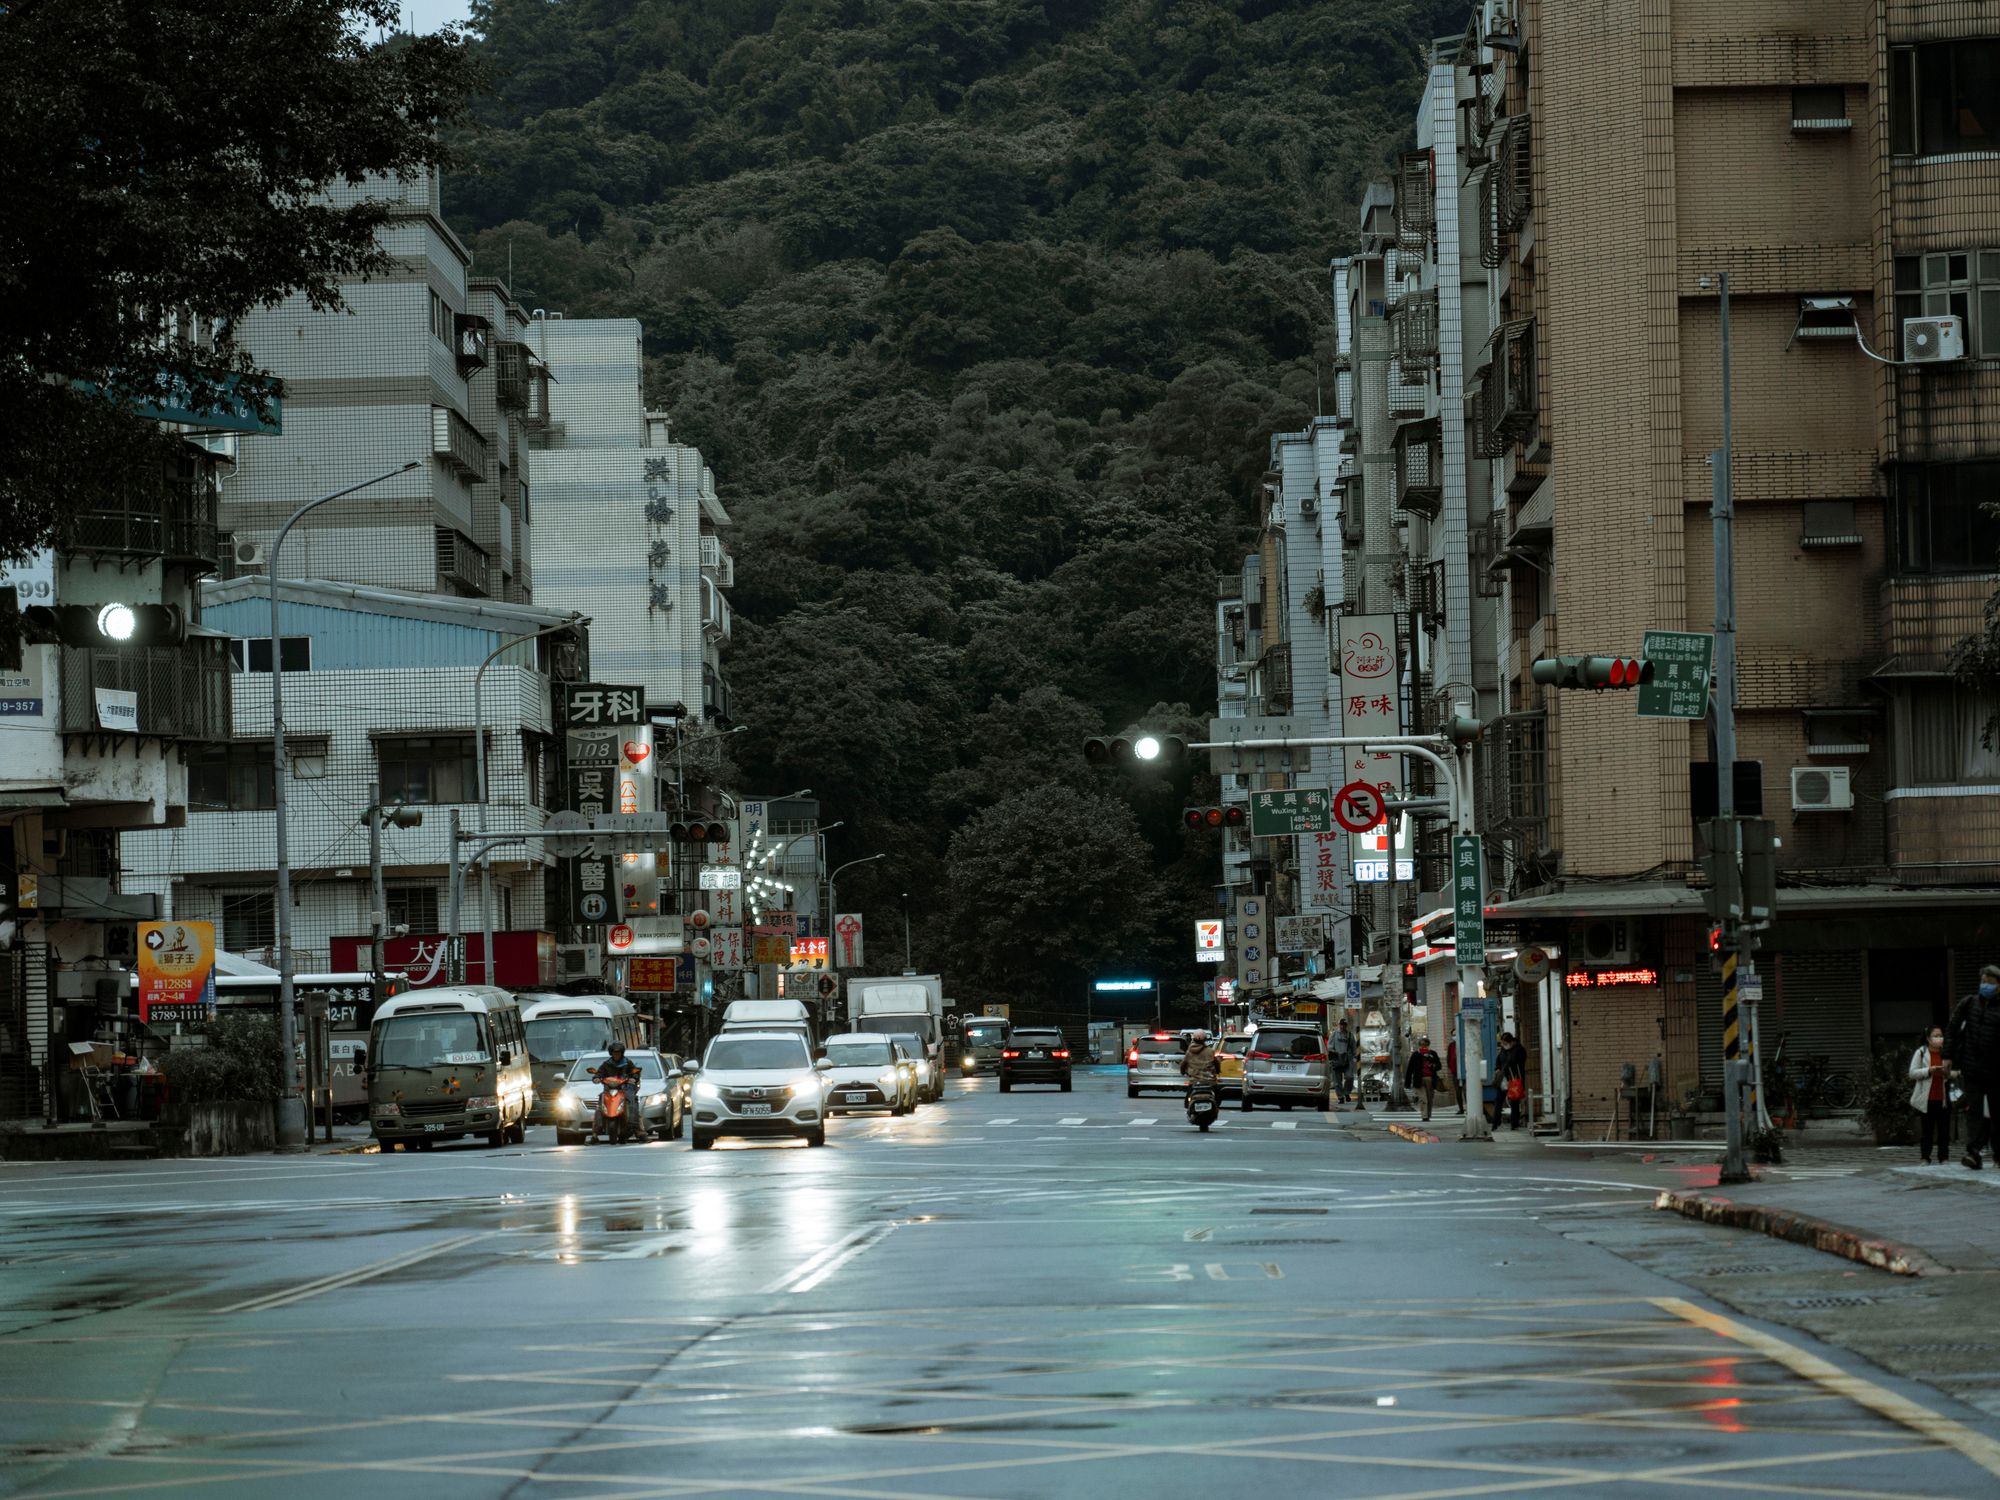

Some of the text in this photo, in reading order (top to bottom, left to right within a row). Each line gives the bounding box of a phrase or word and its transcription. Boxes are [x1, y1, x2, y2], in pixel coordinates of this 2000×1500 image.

[1653, 680, 1678, 690] WuXing
[0, 701, 35, 711] 9-357
[570, 690, 640, 722] 牙科
[1348, 694, 1395, 717] 原味
[576, 743, 610, 757] 108
[1355, 760, 1365, 769] &
[1260, 791, 1321, 808] 吳興街
[1459, 851, 1476, 915] 吳興街
[1457, 920, 1481, 930] WuXing
[151, 1010, 203, 1020] 8789-1111
